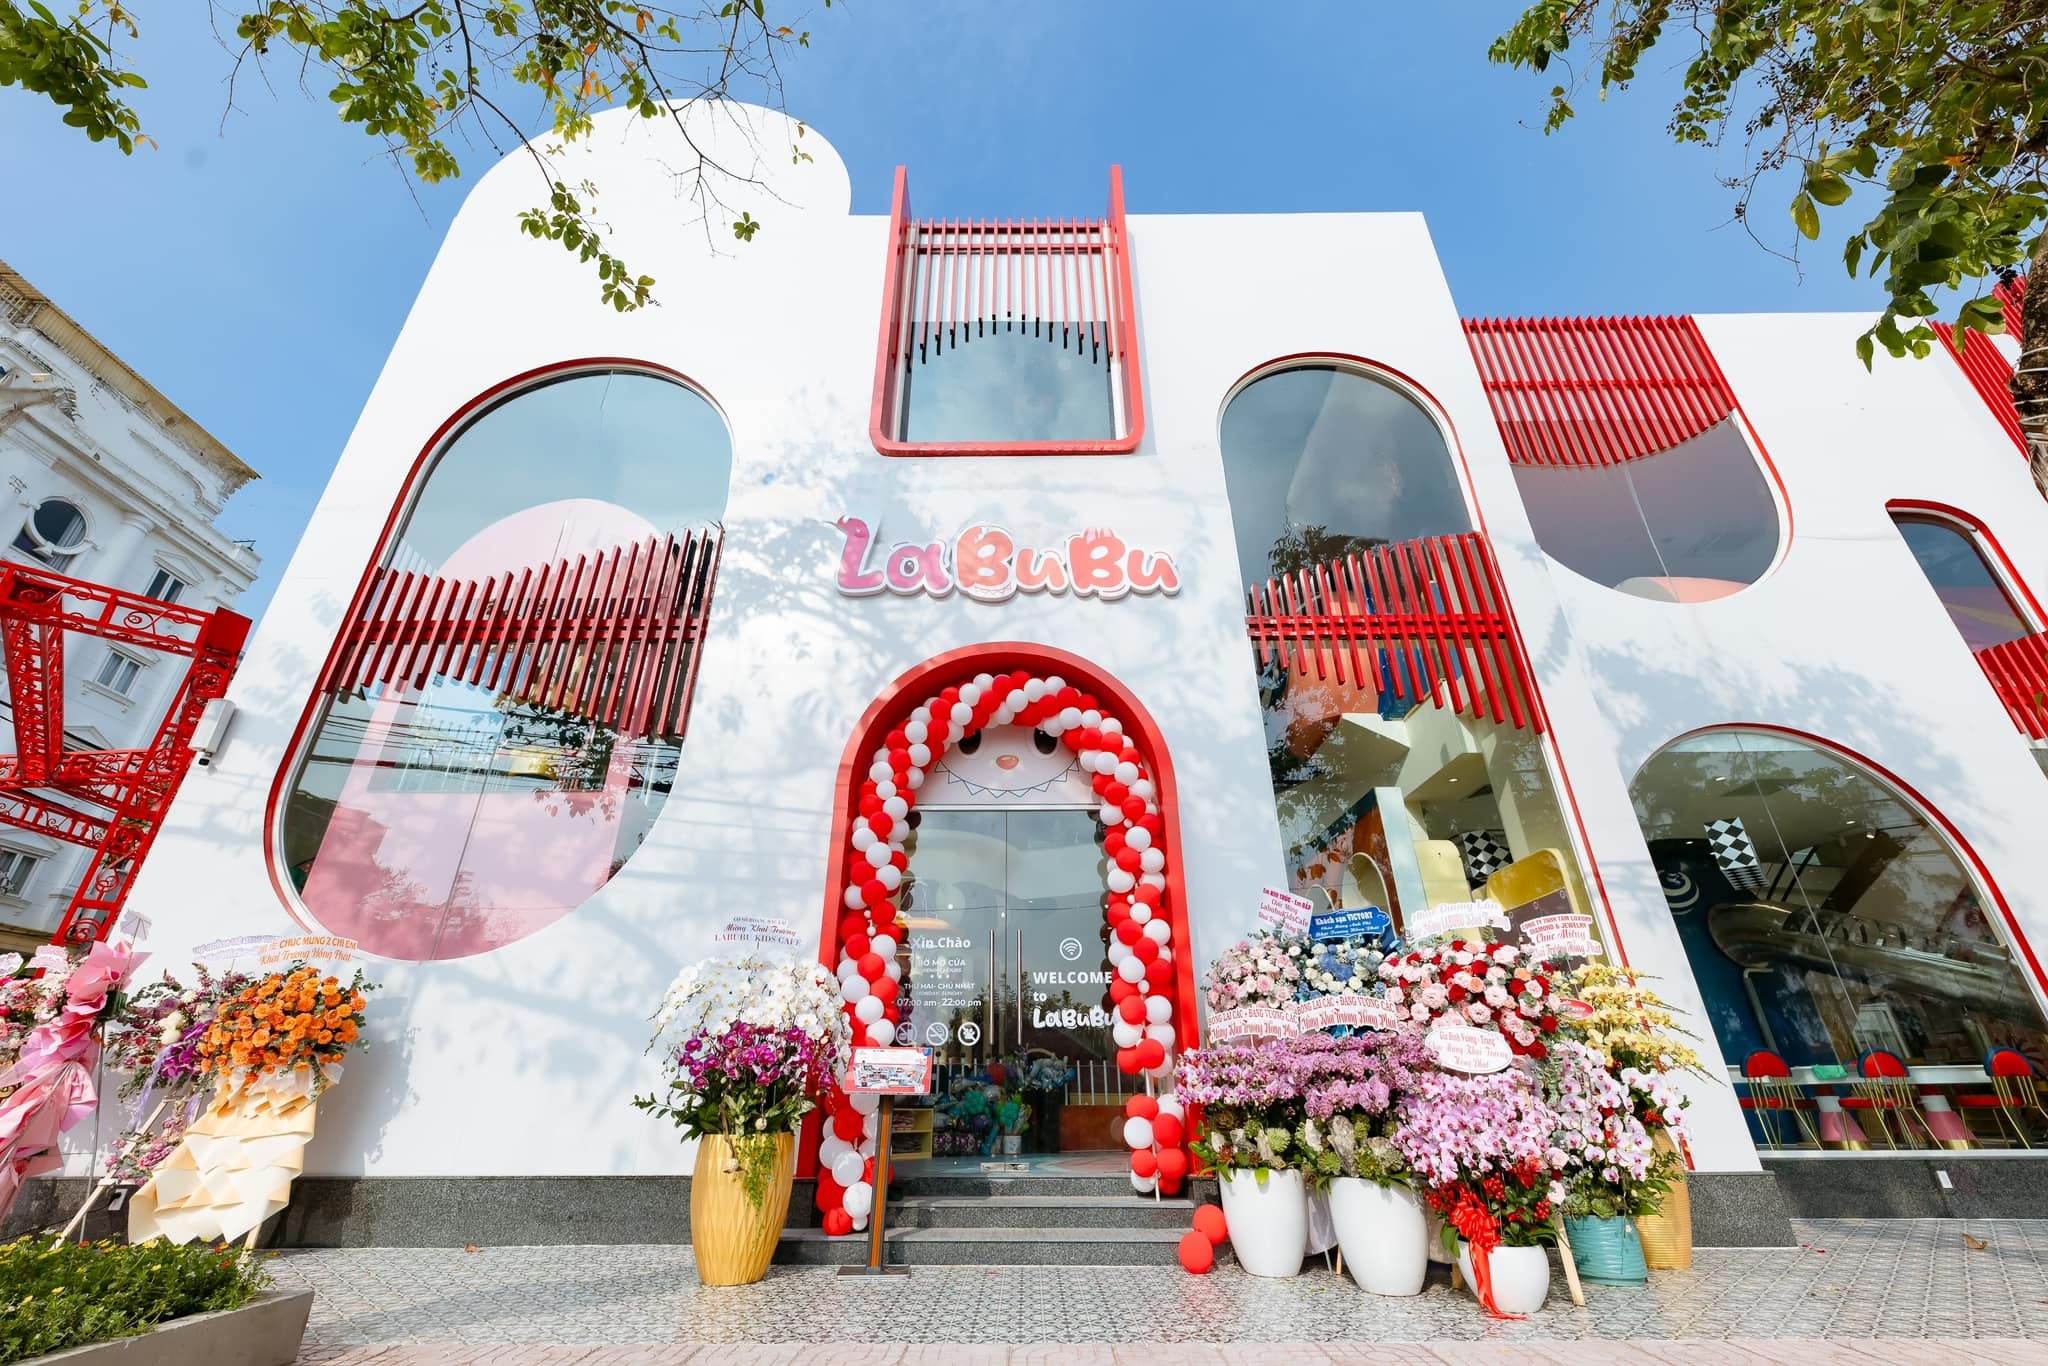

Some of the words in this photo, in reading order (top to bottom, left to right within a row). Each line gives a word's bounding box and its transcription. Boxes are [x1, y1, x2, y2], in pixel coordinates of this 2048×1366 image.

[834, 514, 1183, 601] LaBuBu
[937, 936, 971, 949] Chào
[1033, 971, 1113, 984] WELCOME
[941, 998, 966, 1007] 22:00
[967, 1000, 982, 1008] pm
[1033, 991, 1047, 1002] to
